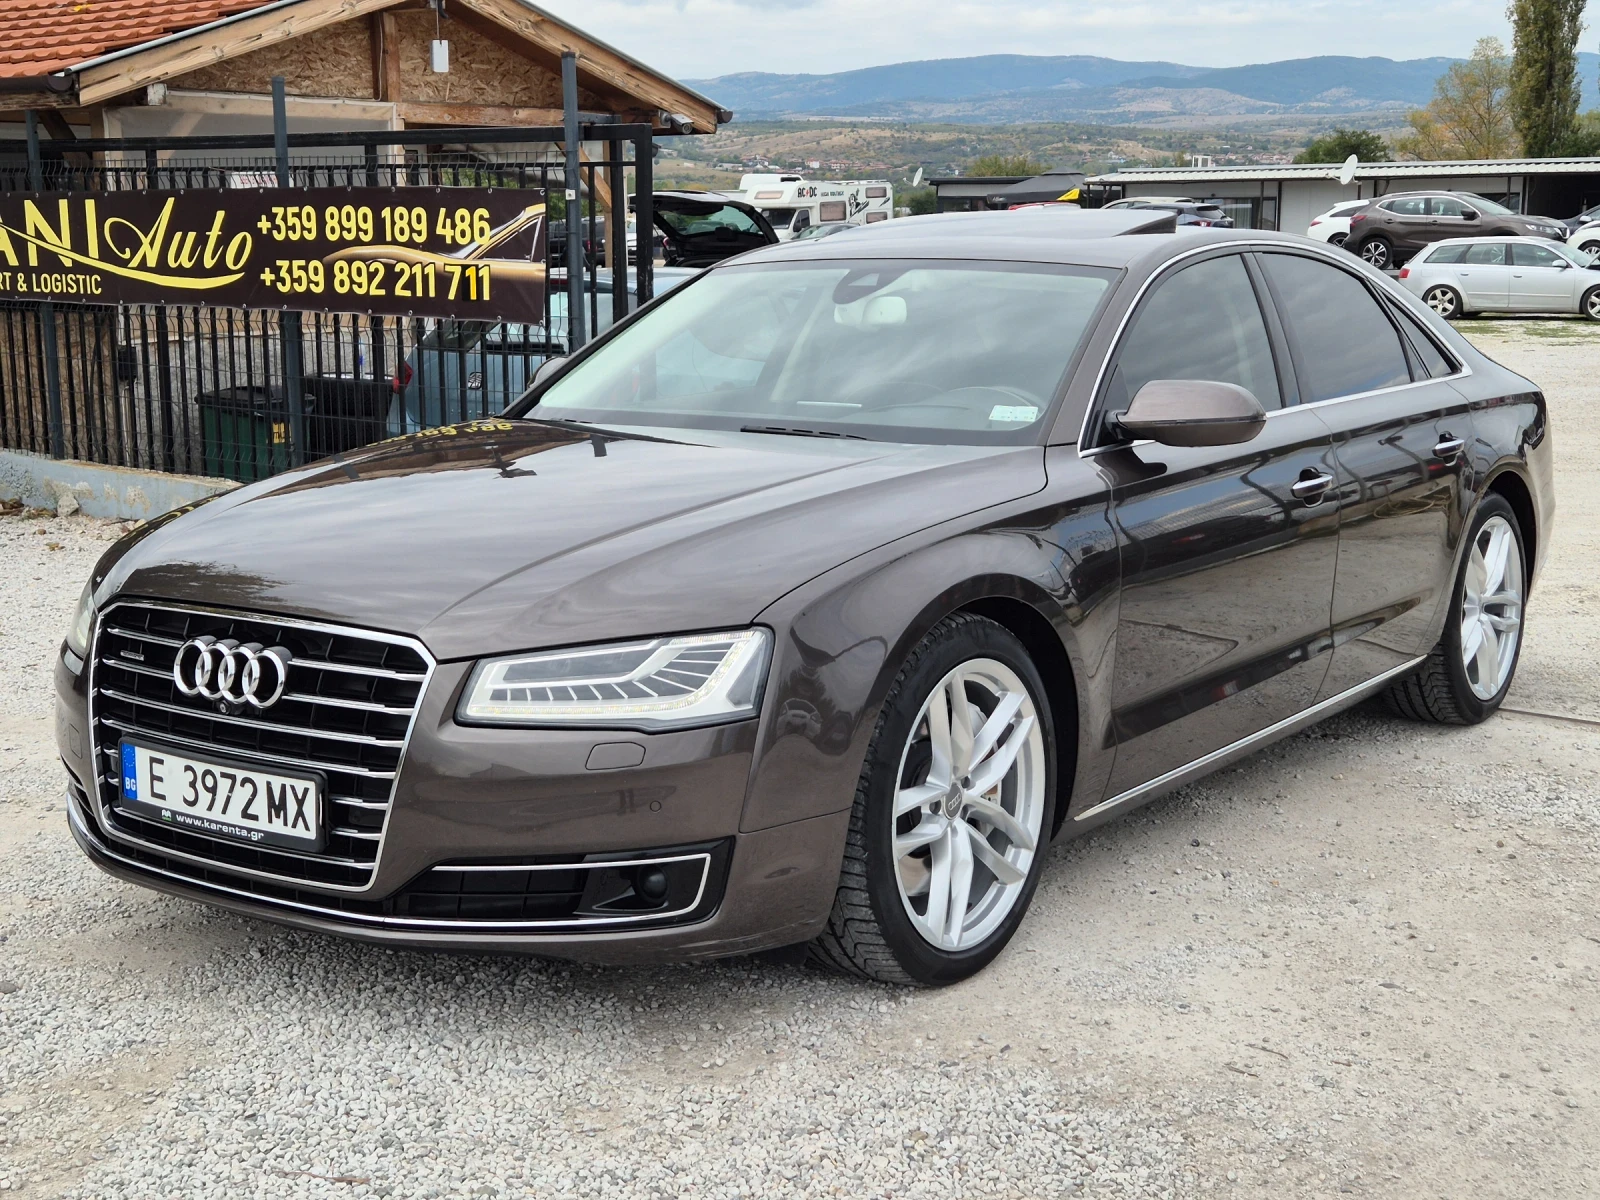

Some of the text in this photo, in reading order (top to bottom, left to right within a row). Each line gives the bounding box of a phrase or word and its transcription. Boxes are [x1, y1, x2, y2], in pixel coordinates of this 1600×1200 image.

[104, 197, 253, 270] Auto
[257, 205, 491, 245] +359 899 189 486
[17, 272, 28, 292] &
[32, 273, 102, 294] LOGISTIC
[260, 259, 491, 300] +359 892 211 711
[125, 777, 137, 791] BG
[149, 755, 311, 832] E 3972 MX
[176, 813, 265, 840] www.karenta.gr
